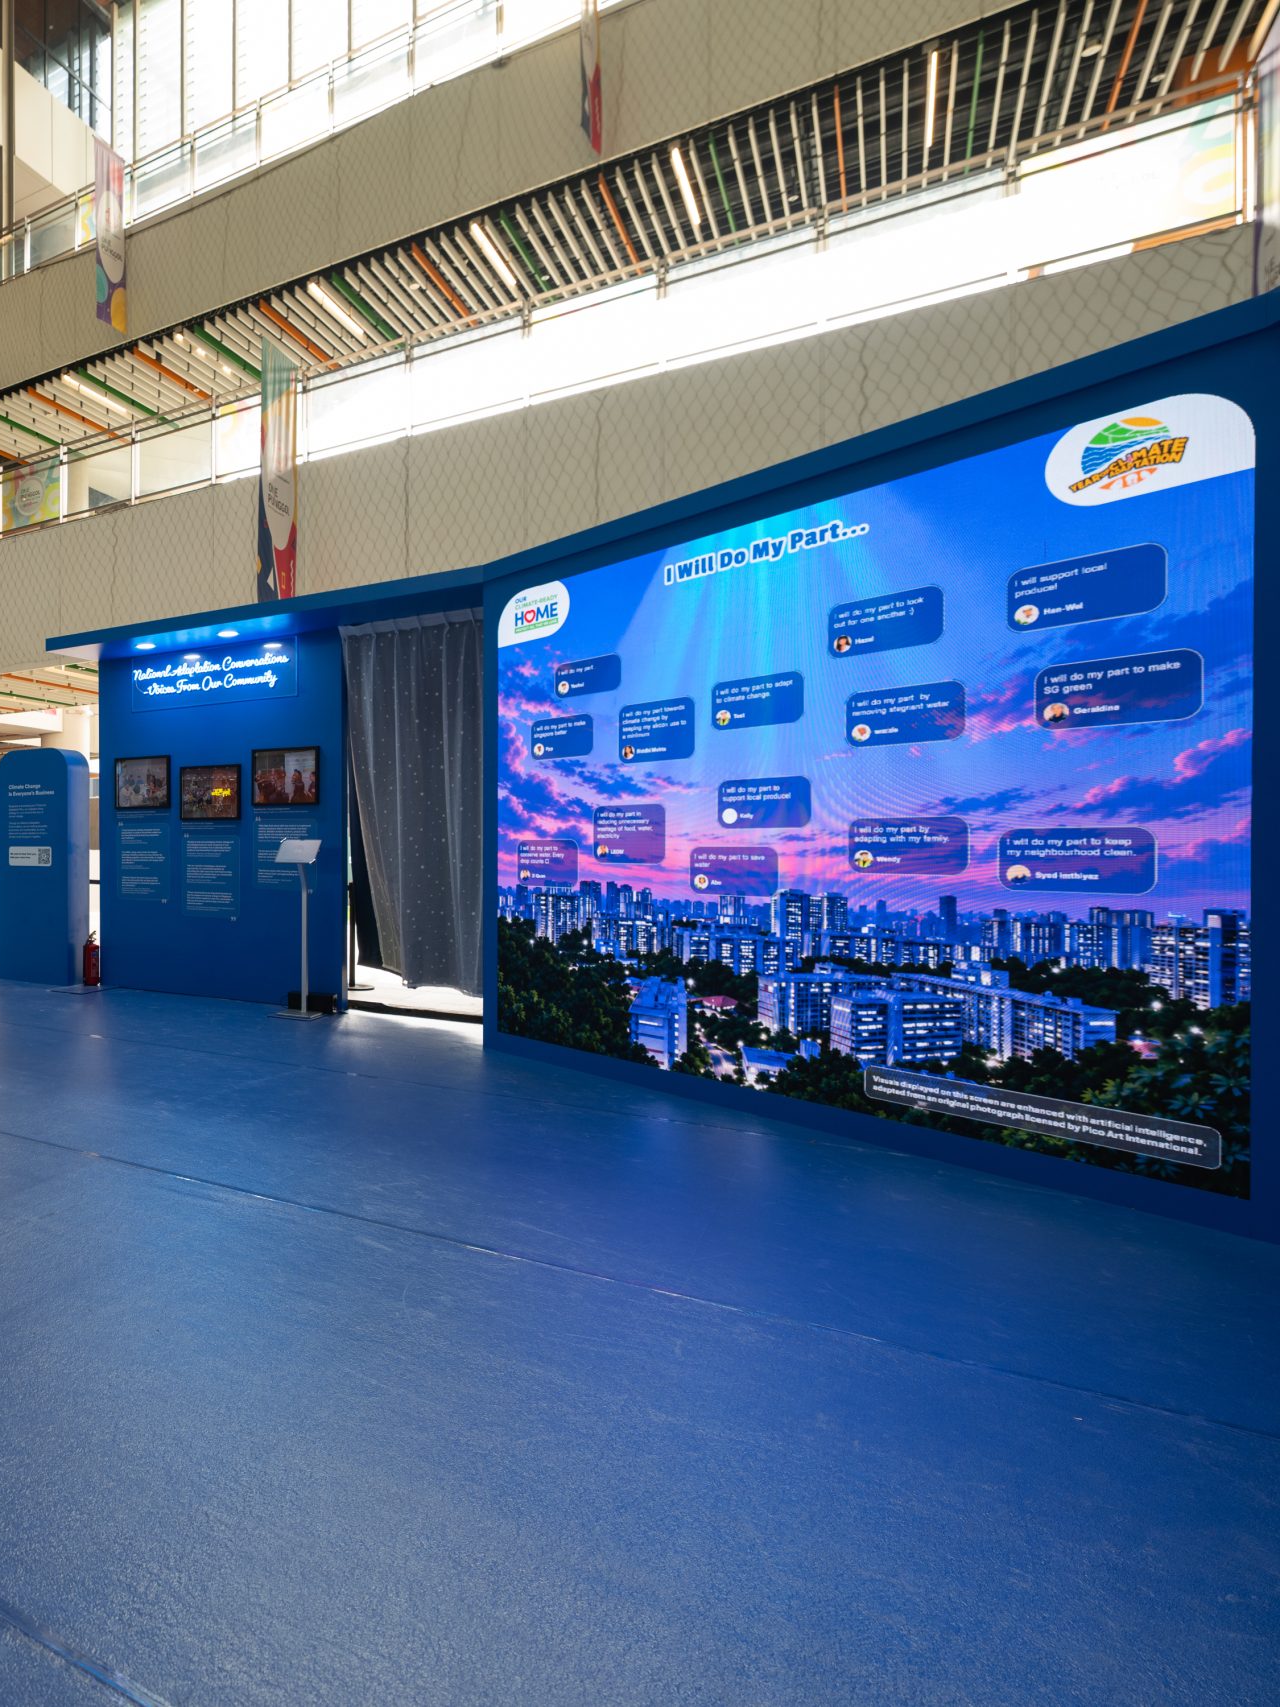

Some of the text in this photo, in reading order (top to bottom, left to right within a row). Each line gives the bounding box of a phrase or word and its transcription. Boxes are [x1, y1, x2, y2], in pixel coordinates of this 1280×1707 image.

[1108, 452, 1183, 479] ADAPTATION
[1069, 473, 1100, 493] YEAR
[665, 520, 869, 585] I Will Do My Part...
[1021, 577, 1037, 586] will
[1040, 569, 1078, 582] support
[1082, 563, 1107, 575] local
[878, 603, 894, 612] part
[907, 597, 924, 605] look
[515, 602, 558, 627] HOME
[877, 610, 906, 620] another
[222, 653, 289, 671] Conversations
[1050, 674, 1067, 683] will
[1070, 672, 1084, 681] do
[1087, 670, 1104, 680] my
[1107, 668, 1130, 678] part
[1133, 666, 1144, 674] to
[1148, 661, 1181, 672] make
[176, 679, 200, 693] From
[202, 676, 222, 691] Our
[224, 670, 278, 688] Community
[752, 684, 764, 692] part
[775, 680, 793, 688] adapt
[1044, 683, 1092, 695] SG green
[898, 694, 914, 703] part
[852, 708, 886, 716] removing
[889, 703, 924, 712] stagnant
[759, 785, 772, 793] part
[854, 836, 887, 844] adapting
[908, 836, 921, 844] my
[1013, 838, 1029, 846] will
[1031, 838, 1045, 846] do
[1047, 839, 1063, 847] my
[1066, 838, 1087, 847] part
[1091, 838, 1102, 846] to
[1105, 838, 1132, 847] keep
[1007, 848, 1136, 858] my neighbourhood clean.
[872, 1075, 899, 1086] Visuals
[900, 1081, 940, 1095] displayed
[940, 1089, 952, 1097] on
[953, 1091, 969, 1100] this
[969, 1095, 1000, 1106] screen
[1000, 1100, 1016, 1109] are
[1016, 1103, 1065, 1119] enhanced
[1066, 1113, 1089, 1123] with
[1090, 1117, 1134, 1132] artificial
[872, 1084, 906, 1097] adapted
[906, 1090, 926, 1101] from
[938, 1096, 970, 1109] original
[970, 1104, 1024, 1121] photograph
[1025, 1115, 1066, 1129] licensed
[1067, 1121, 1081, 1133] by
[1082, 1124, 1106, 1137] Pico
[1106, 1130, 1125, 1141] Art
